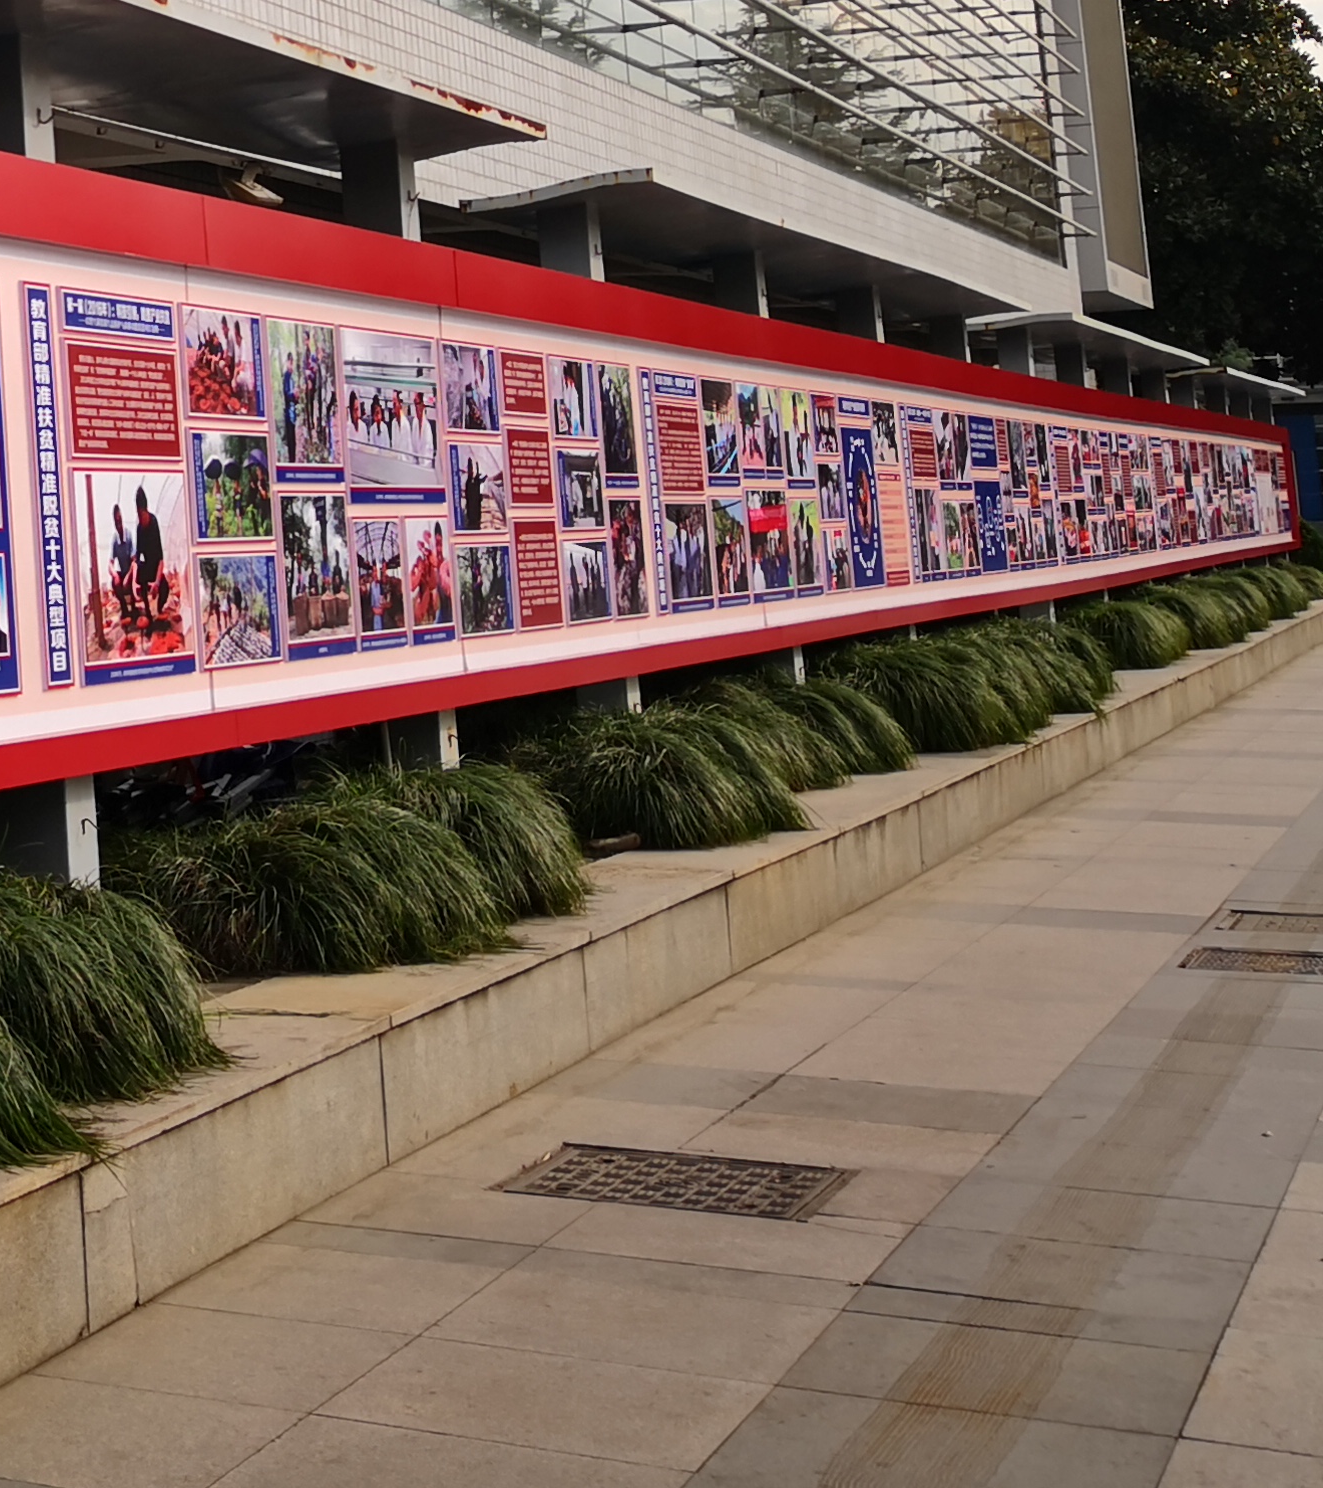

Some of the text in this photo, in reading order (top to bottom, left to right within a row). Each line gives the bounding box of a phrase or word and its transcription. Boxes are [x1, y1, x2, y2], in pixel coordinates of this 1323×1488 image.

[30, 298, 67, 672] 教育部精准扶贫精准脱贫十大典型项目
